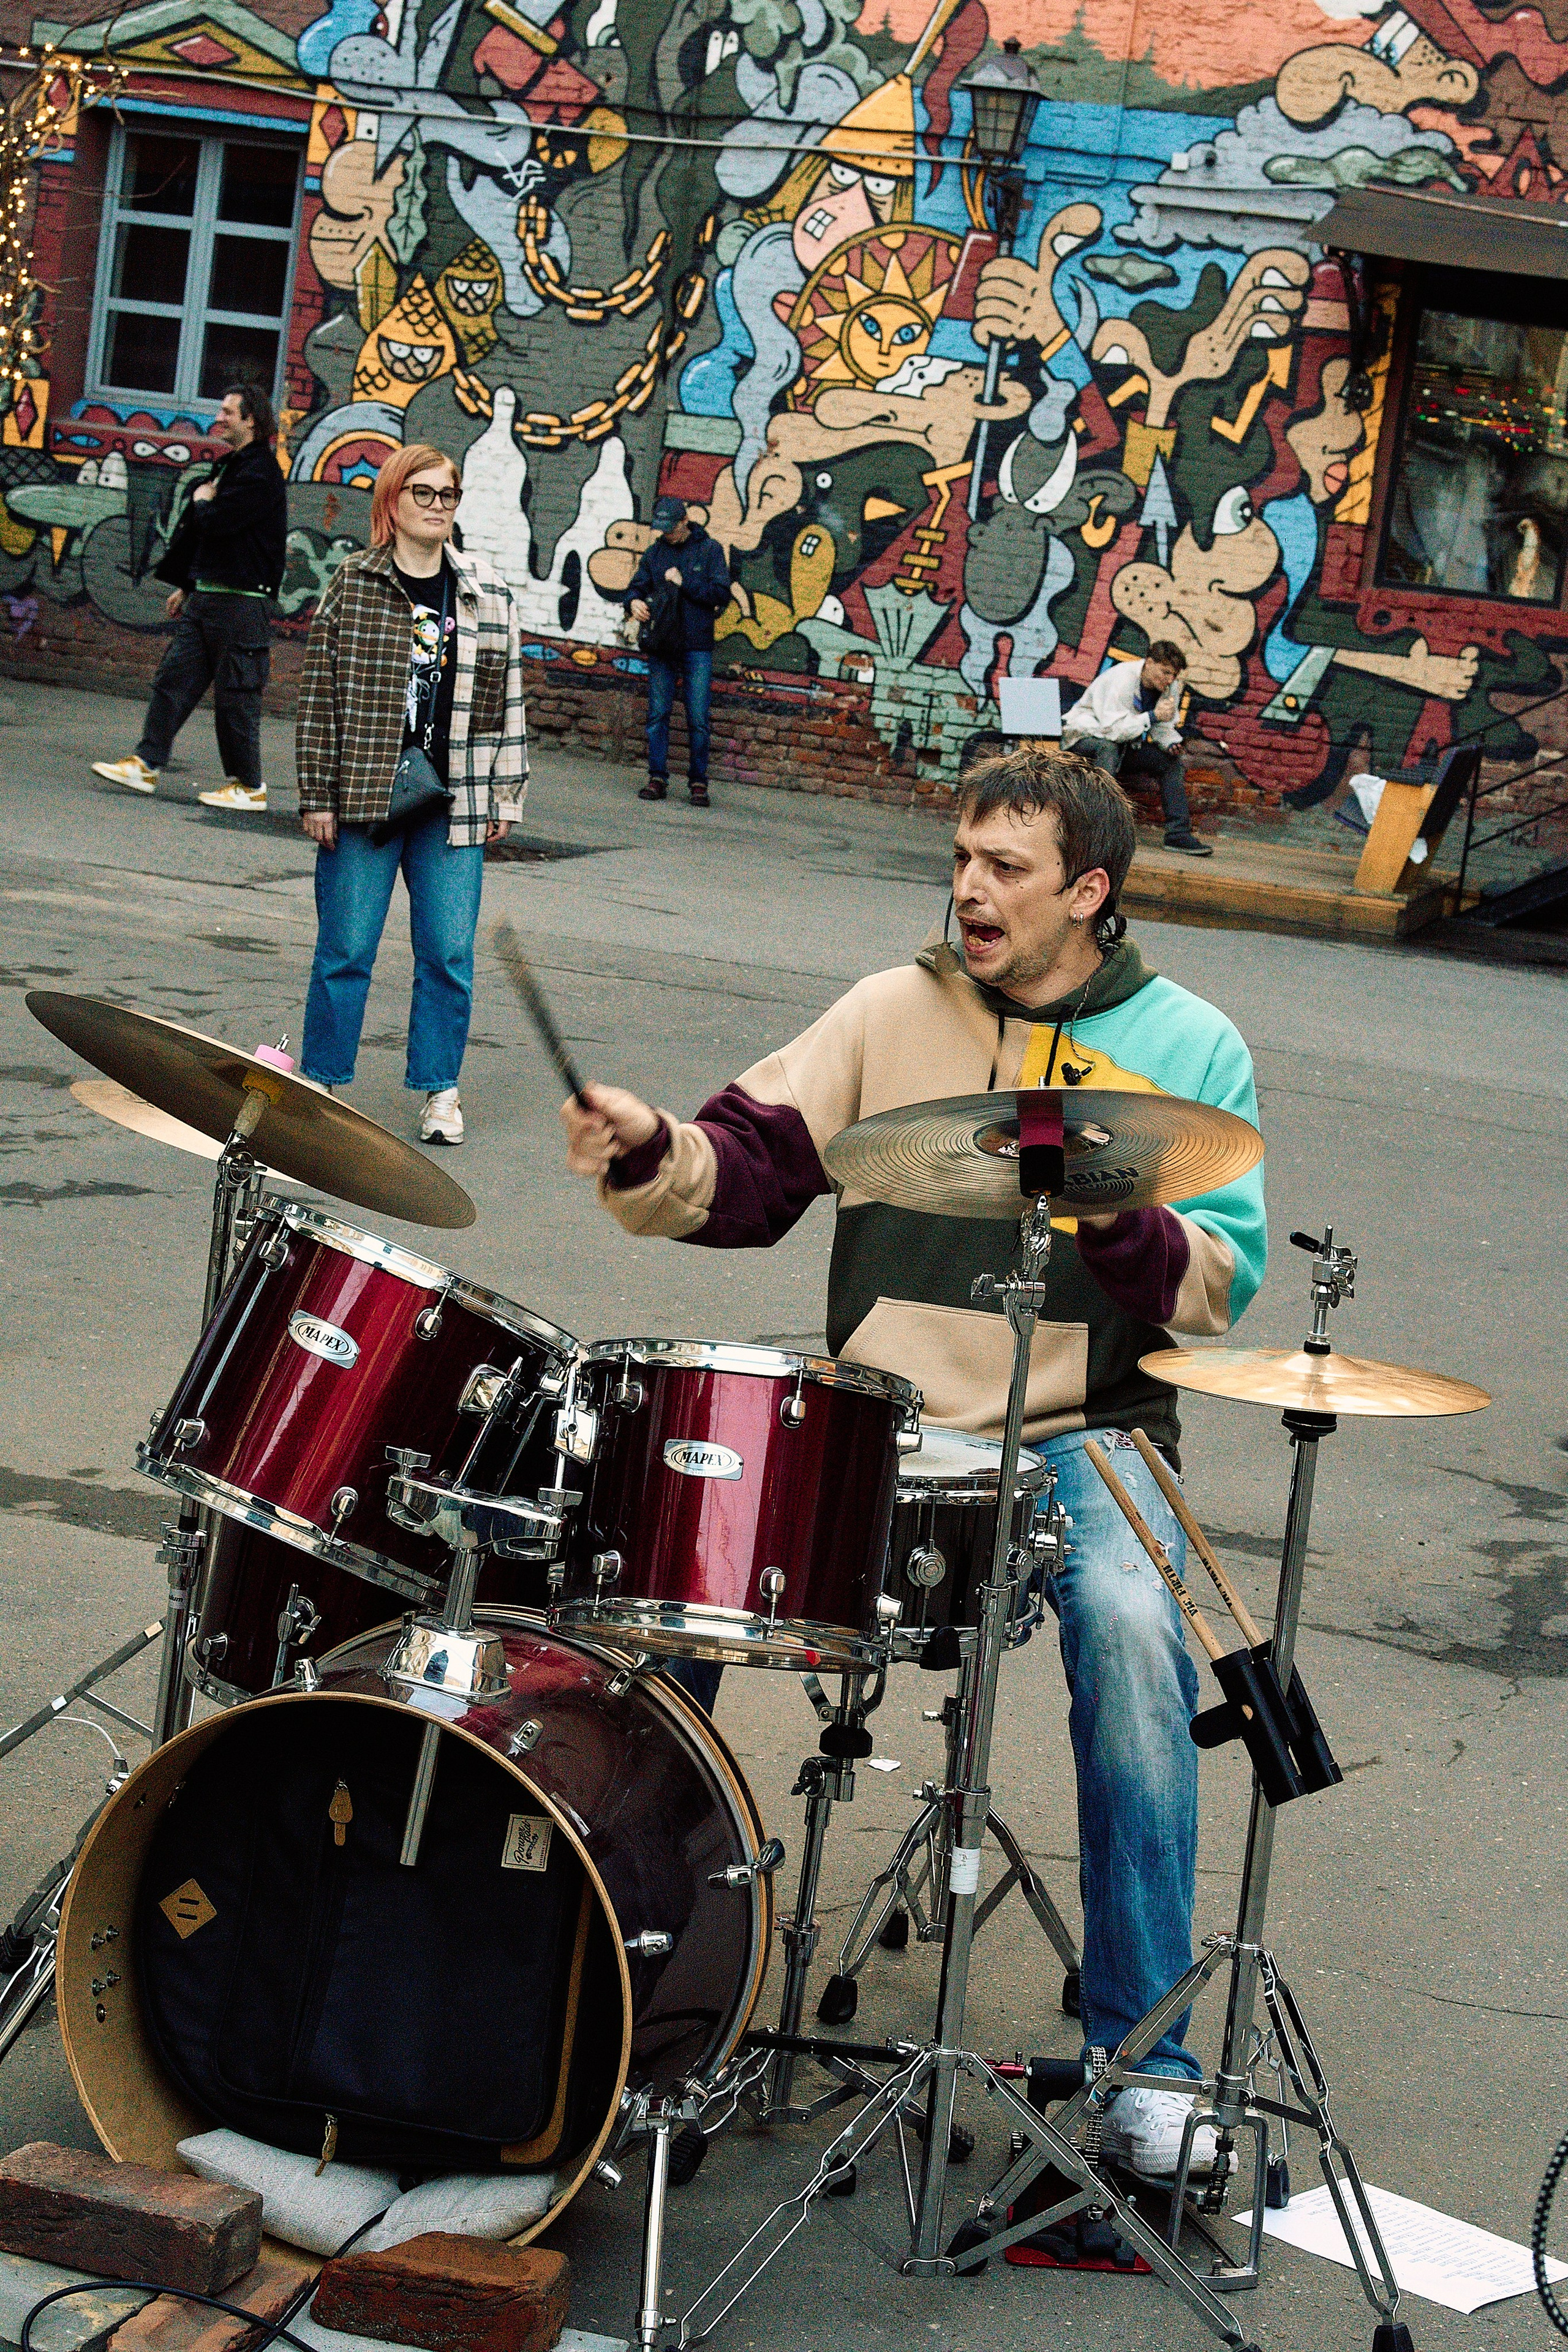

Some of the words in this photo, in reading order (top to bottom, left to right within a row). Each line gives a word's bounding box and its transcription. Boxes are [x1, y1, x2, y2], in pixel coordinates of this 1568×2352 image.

[301, 1325, 345, 1352] MAPEX
[679, 1451, 725, 1466] MAPEX
[1163, 1564, 1187, 1597] FIRTH
[1183, 1597, 1199, 1617] VIC
[514, 1826, 530, 1864] Power
